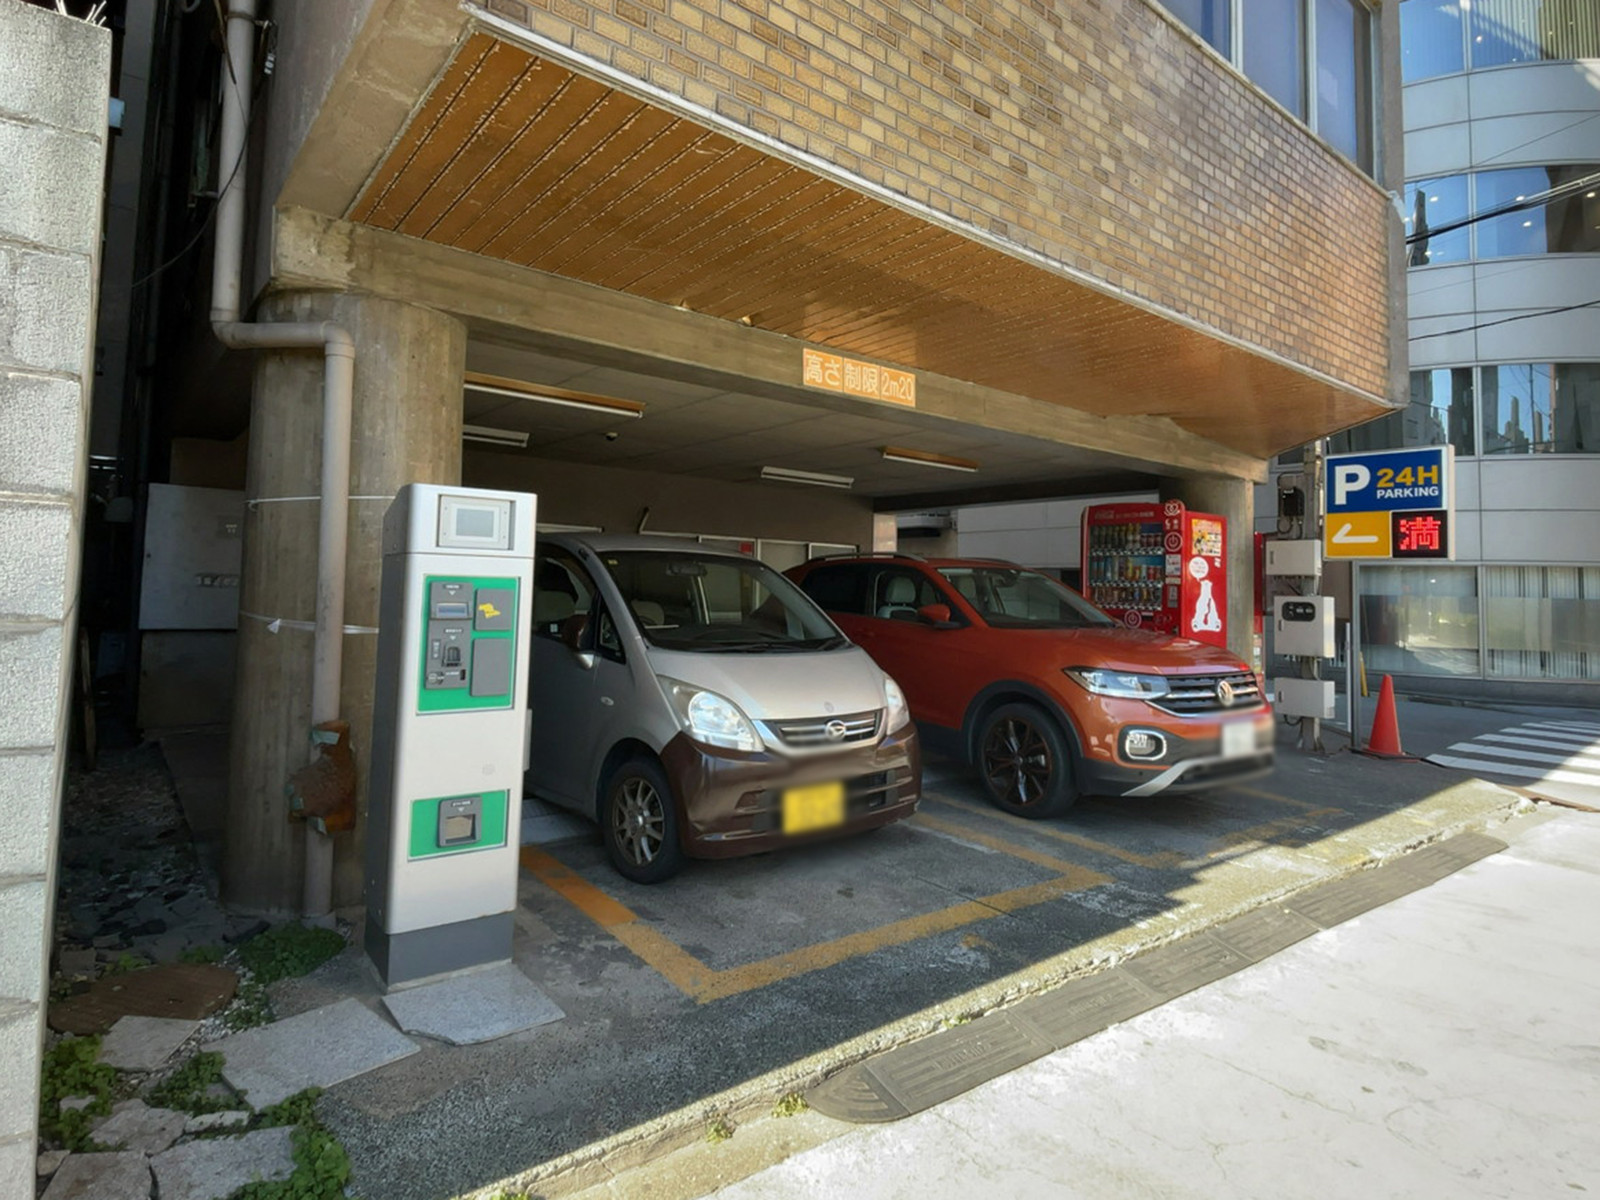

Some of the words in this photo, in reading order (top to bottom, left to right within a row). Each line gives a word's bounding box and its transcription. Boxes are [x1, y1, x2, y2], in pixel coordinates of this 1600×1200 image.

[1335, 464, 1371, 505] P
[1376, 465, 1438, 488] 24H
[1376, 486, 1439, 499] PARKING
[1399, 516, 1440, 550] 満
